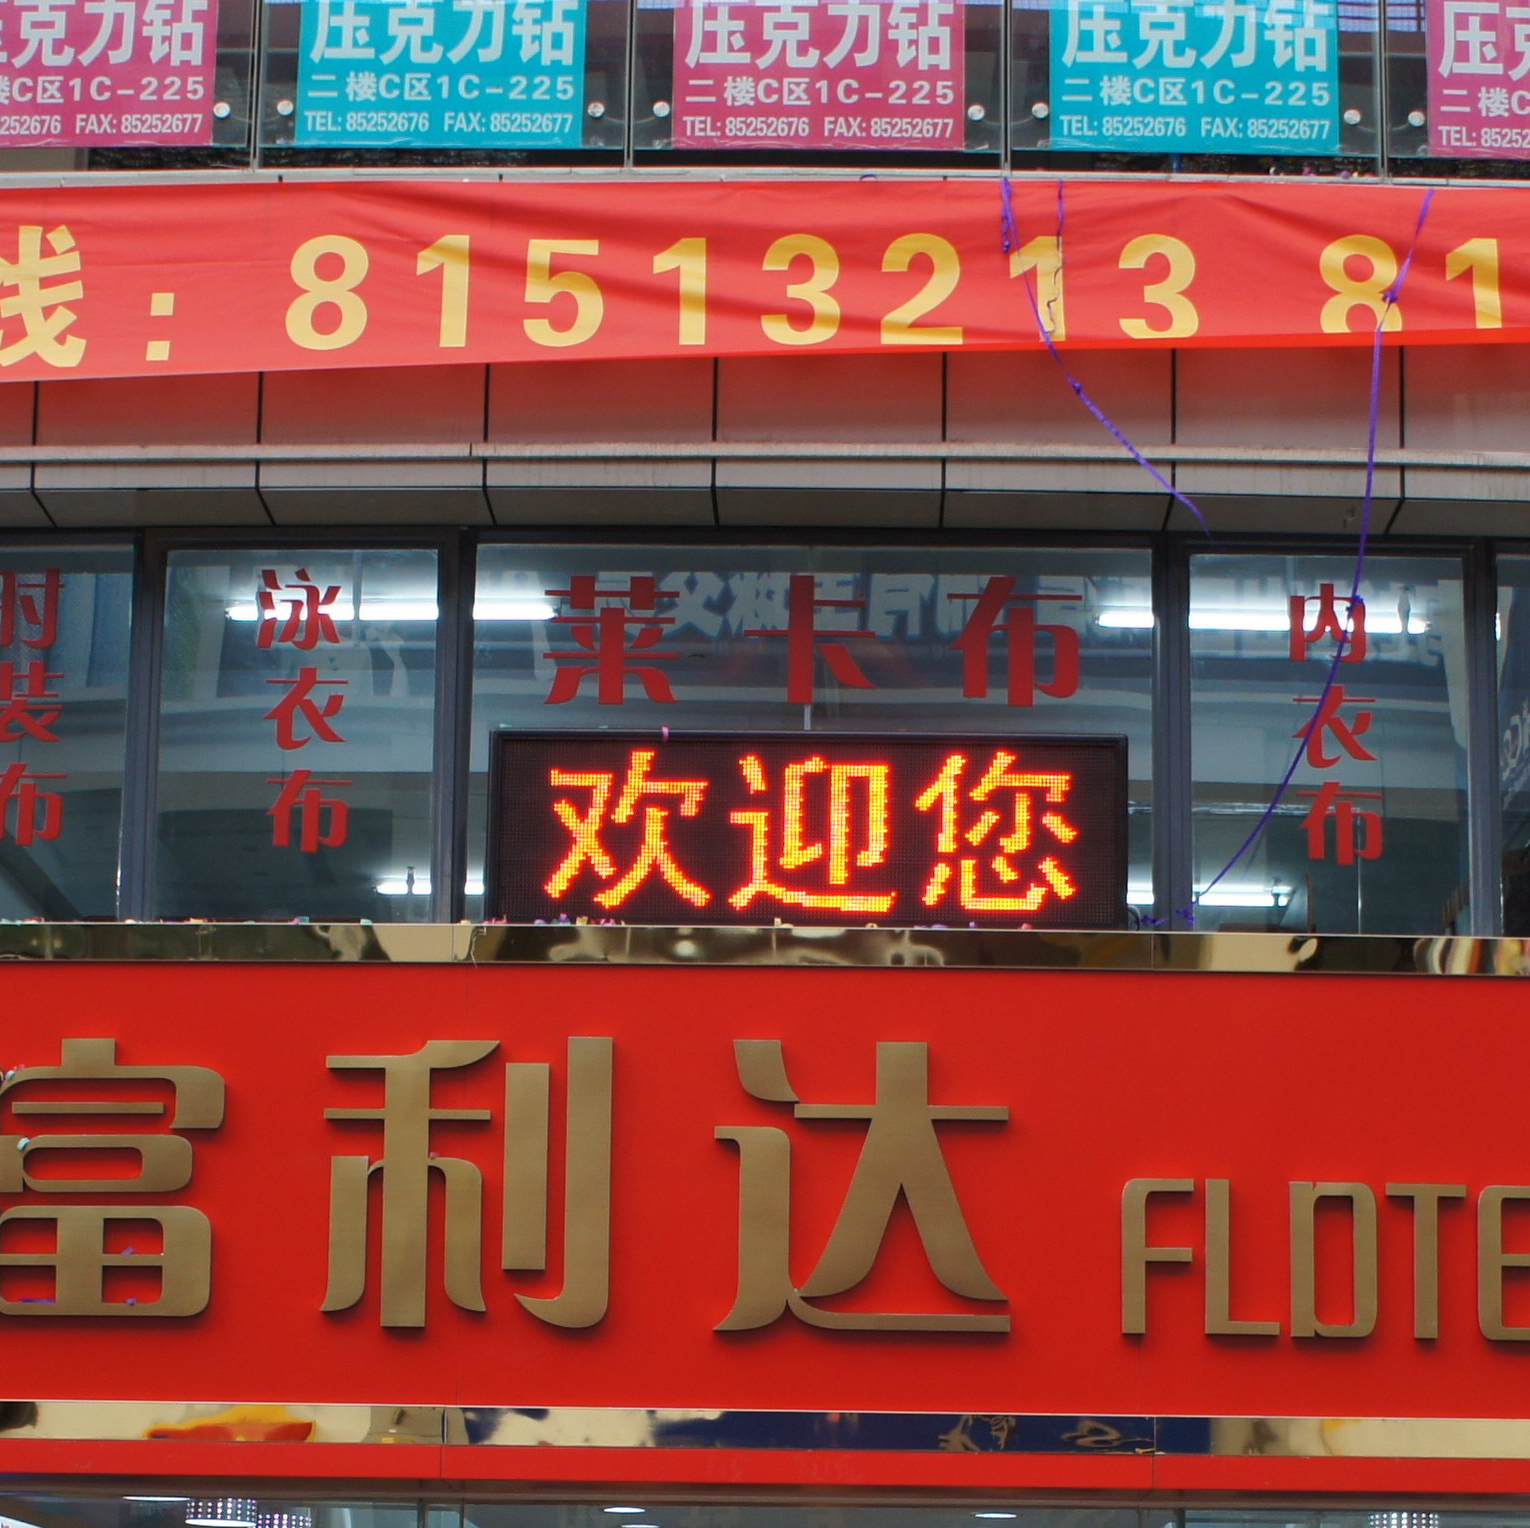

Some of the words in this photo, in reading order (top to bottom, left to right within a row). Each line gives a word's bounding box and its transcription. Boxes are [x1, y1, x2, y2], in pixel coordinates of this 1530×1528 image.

[309, 0, 579, 66] 压克力钻
[685, 0, 955, 70] 压克力钻
[1062, 0, 1329, 72] 压克力钻
[75, 114, 117, 135] FAX:
[121, 114, 203, 134] 85252677
[304, 111, 342, 131] TEL:
[346, 113, 430, 131] 85252676
[443, 112, 486, 132] FAX:
[490, 113, 573, 133] 85252677
[683, 116, 721, 137] TEL:
[725, 117, 810, 137] 85252676
[823, 117, 866, 137] FAX:
[870, 118, 954, 138] 85252677
[1059, 115, 1098, 136] TEL:
[1102, 116, 1187, 137] 85252676
[1201, 117, 1243, 138] FAX:
[1247, 119, 1330, 139] 85252677
[1437, 126, 1476, 147] TEL:
[286, 234, 1199, 350] 81513213
[543, 575, 1083, 707] 莱卡布
[254, 567, 352, 853] 泳衣布
[1288, 583, 1384, 866] 内衣布
[544, 748, 1077, 913] 欢迎您
